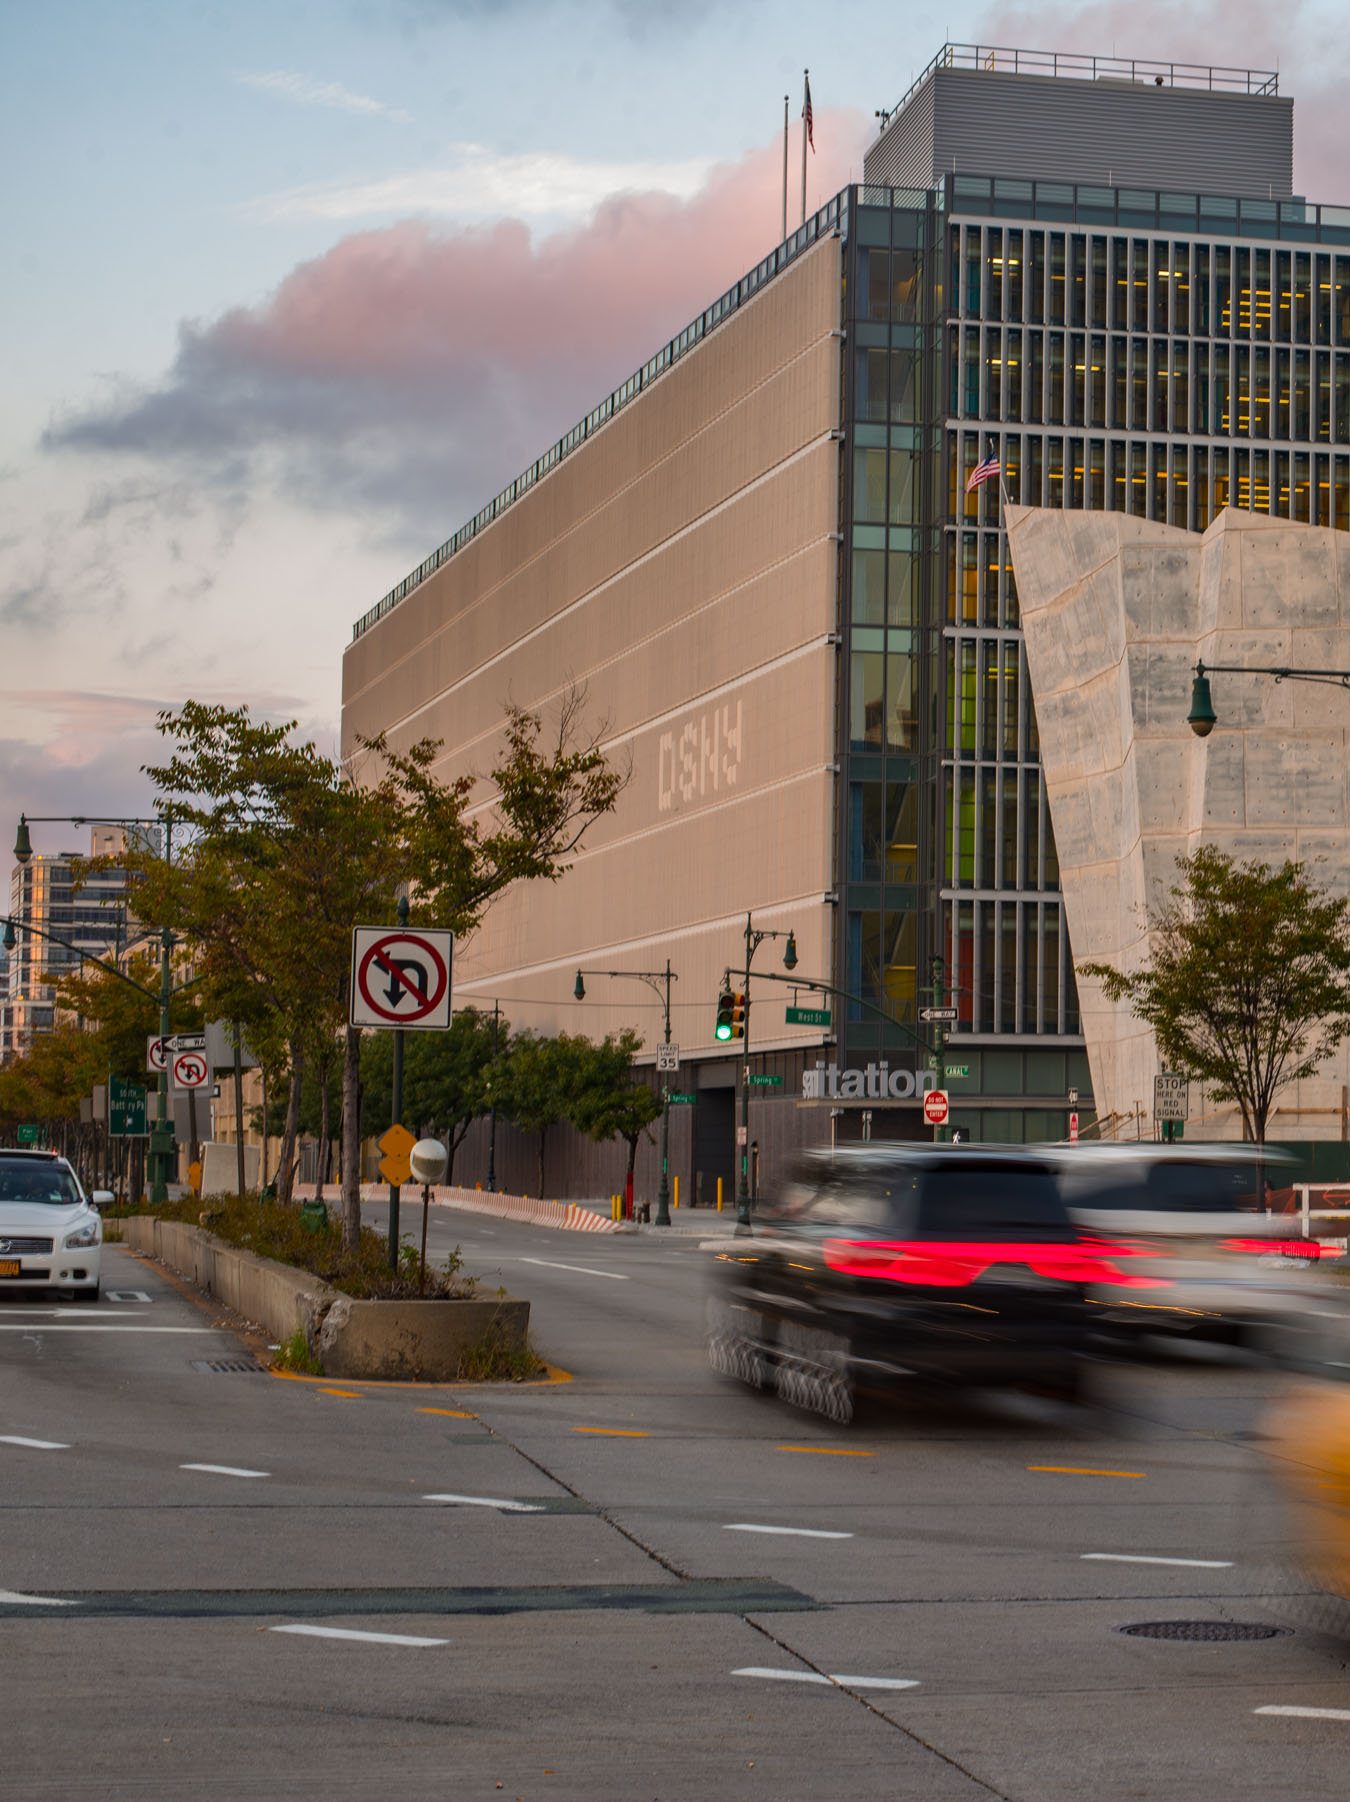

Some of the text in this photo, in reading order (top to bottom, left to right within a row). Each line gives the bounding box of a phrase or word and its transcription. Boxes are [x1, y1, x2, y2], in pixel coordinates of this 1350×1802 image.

[659, 699, 742, 812] DSNY
[798, 1012, 814, 1022] West
[171, 1040, 185, 1048] ONE
[660, 1058, 676, 1068] 35
[754, 1076, 772, 1085] Spring
[1157, 1079, 1186, 1089] STOP
[111, 1100, 135, 1112] Battry
[1157, 1109, 1185, 1117] SIGNAL
